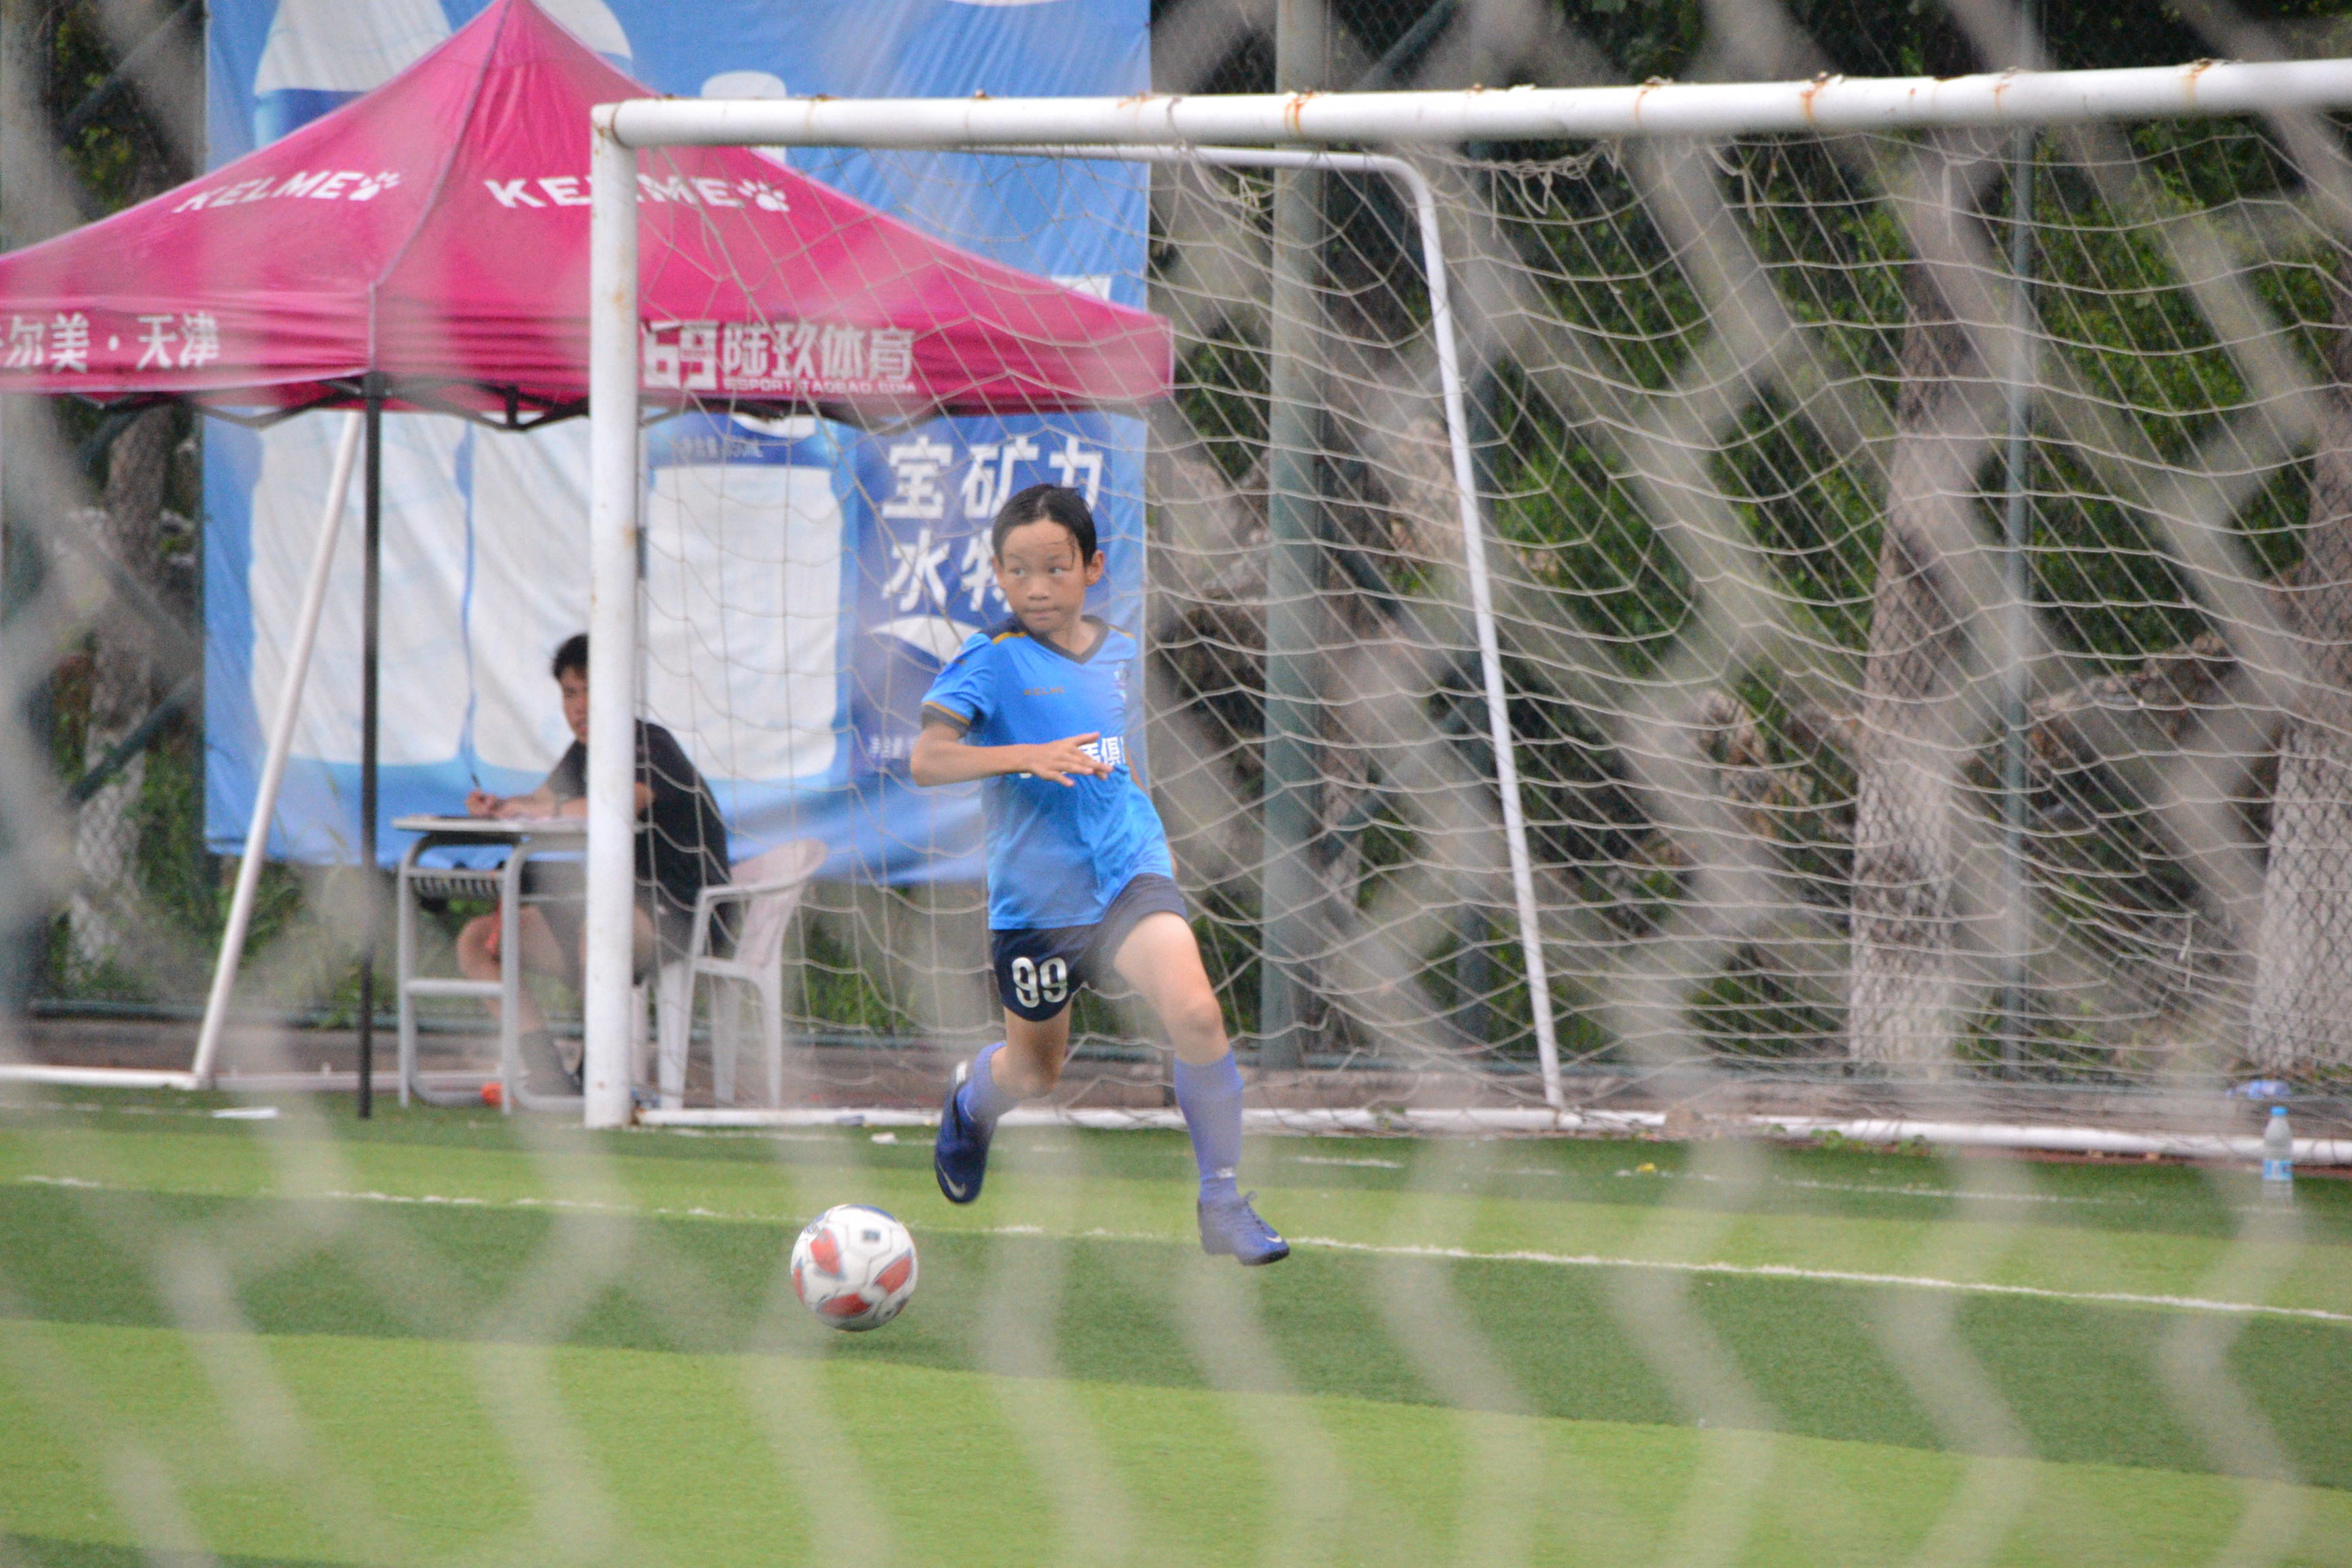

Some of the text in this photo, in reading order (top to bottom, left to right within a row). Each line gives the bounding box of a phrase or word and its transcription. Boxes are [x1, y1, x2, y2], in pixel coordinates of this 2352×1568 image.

[172, 170, 364, 213] KELME
[484, 175, 744, 208] KEME
[0, 311, 220, 374] 尔美·天津
[723, 321, 915, 381] 陆玖体育
[881, 434, 1103, 519] 宝矿力
[1023, 686, 1065, 696] KELME
[1011, 956, 1068, 1008] 99
